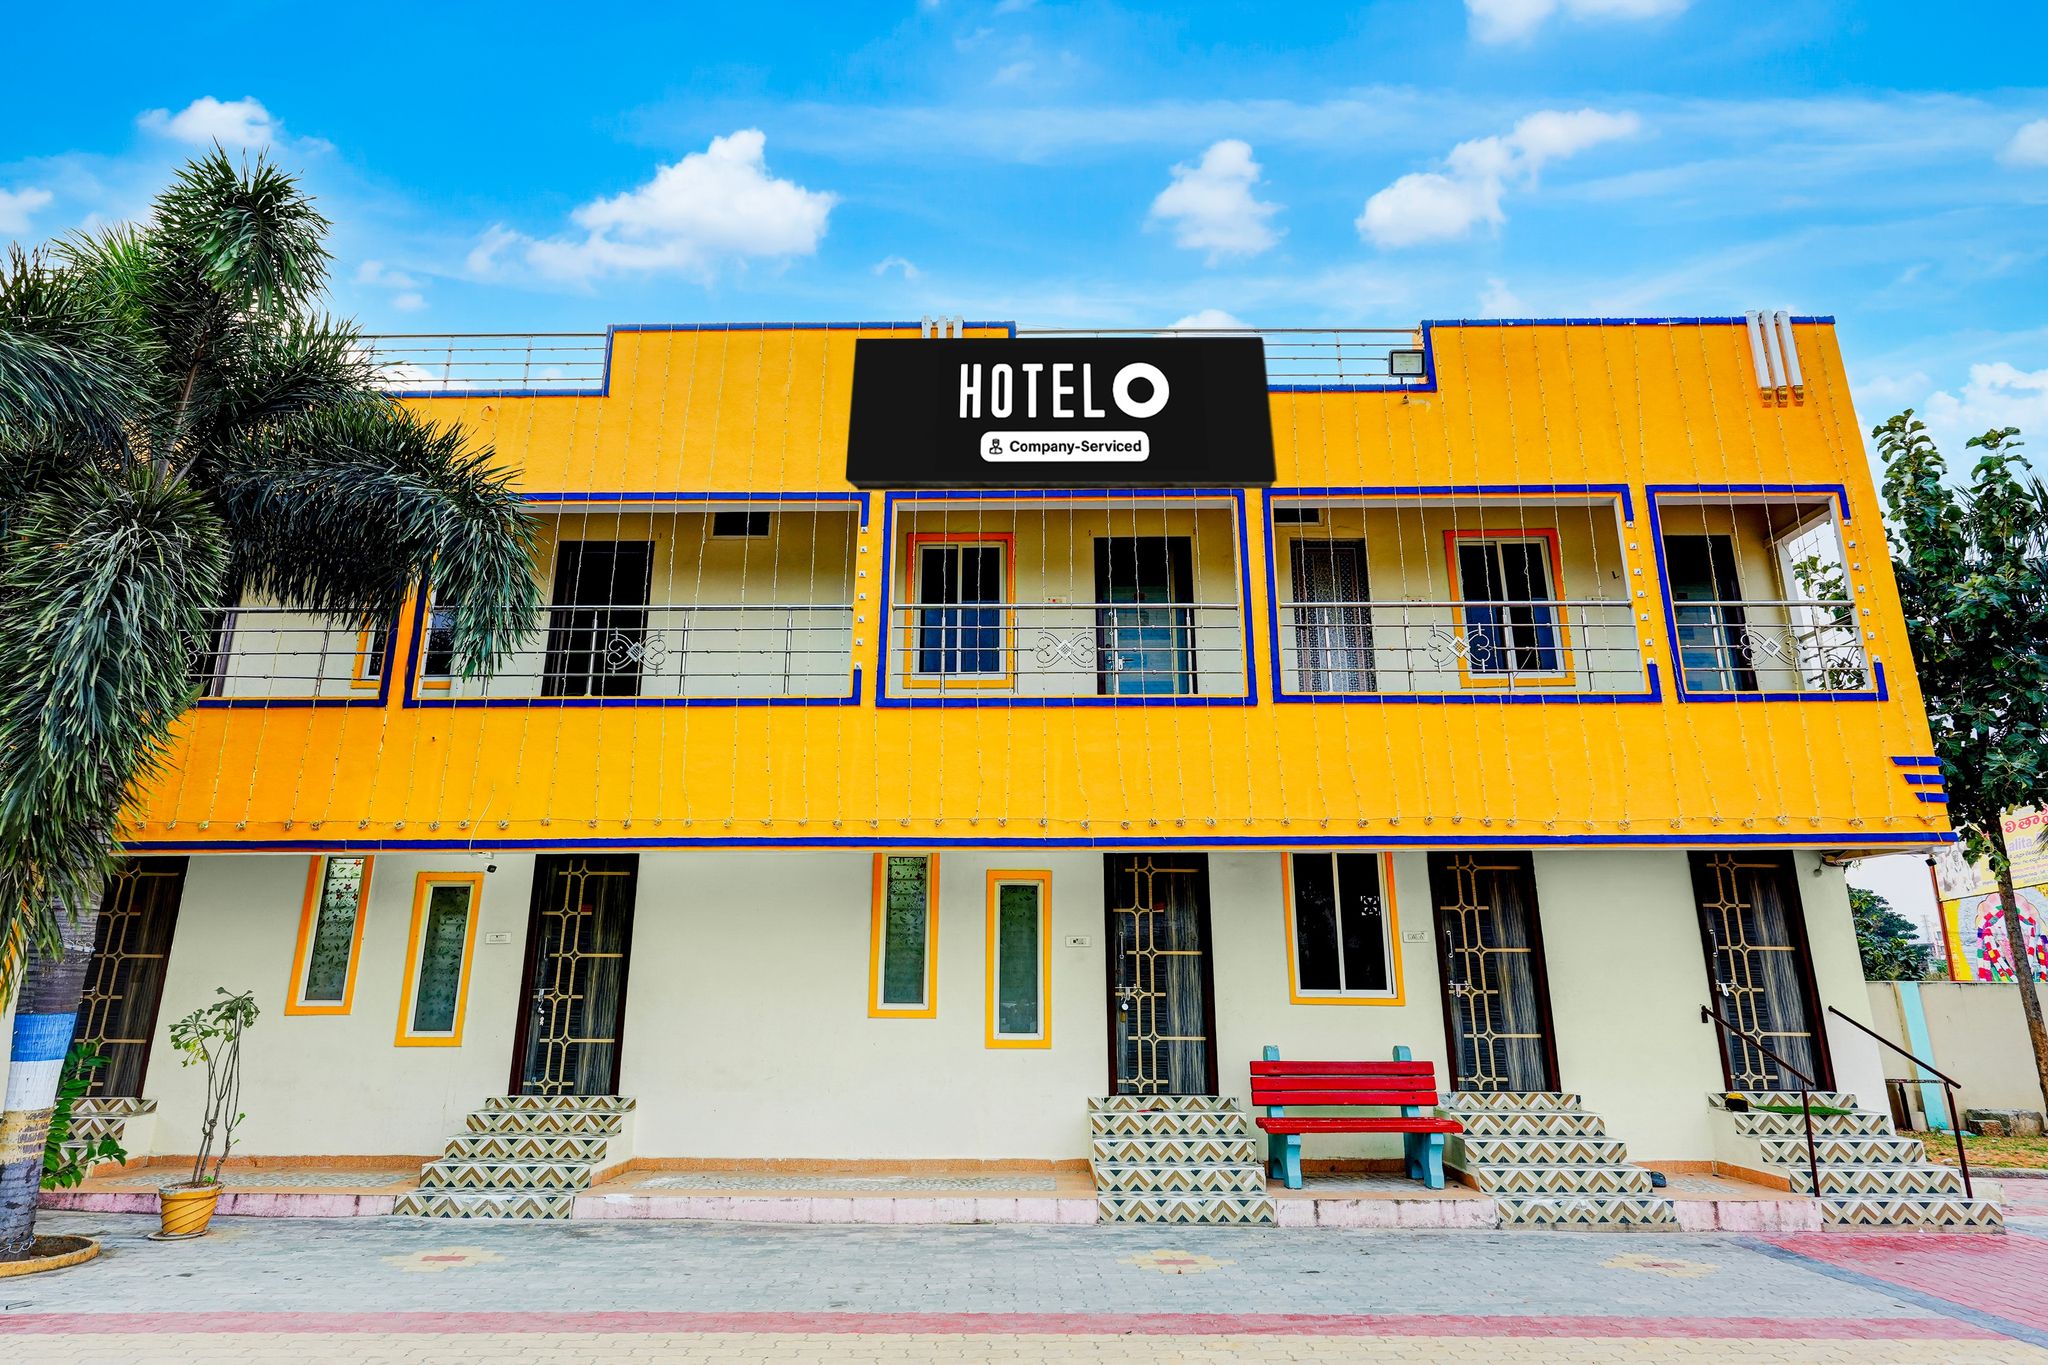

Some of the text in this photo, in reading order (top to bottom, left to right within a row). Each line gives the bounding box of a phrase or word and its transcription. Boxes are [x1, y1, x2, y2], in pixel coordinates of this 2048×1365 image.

[959, 362, 1170, 419] HOTEL O
[1009, 439, 1142, 456] Company-Serviced
[2007, 837, 2033, 852] alita
